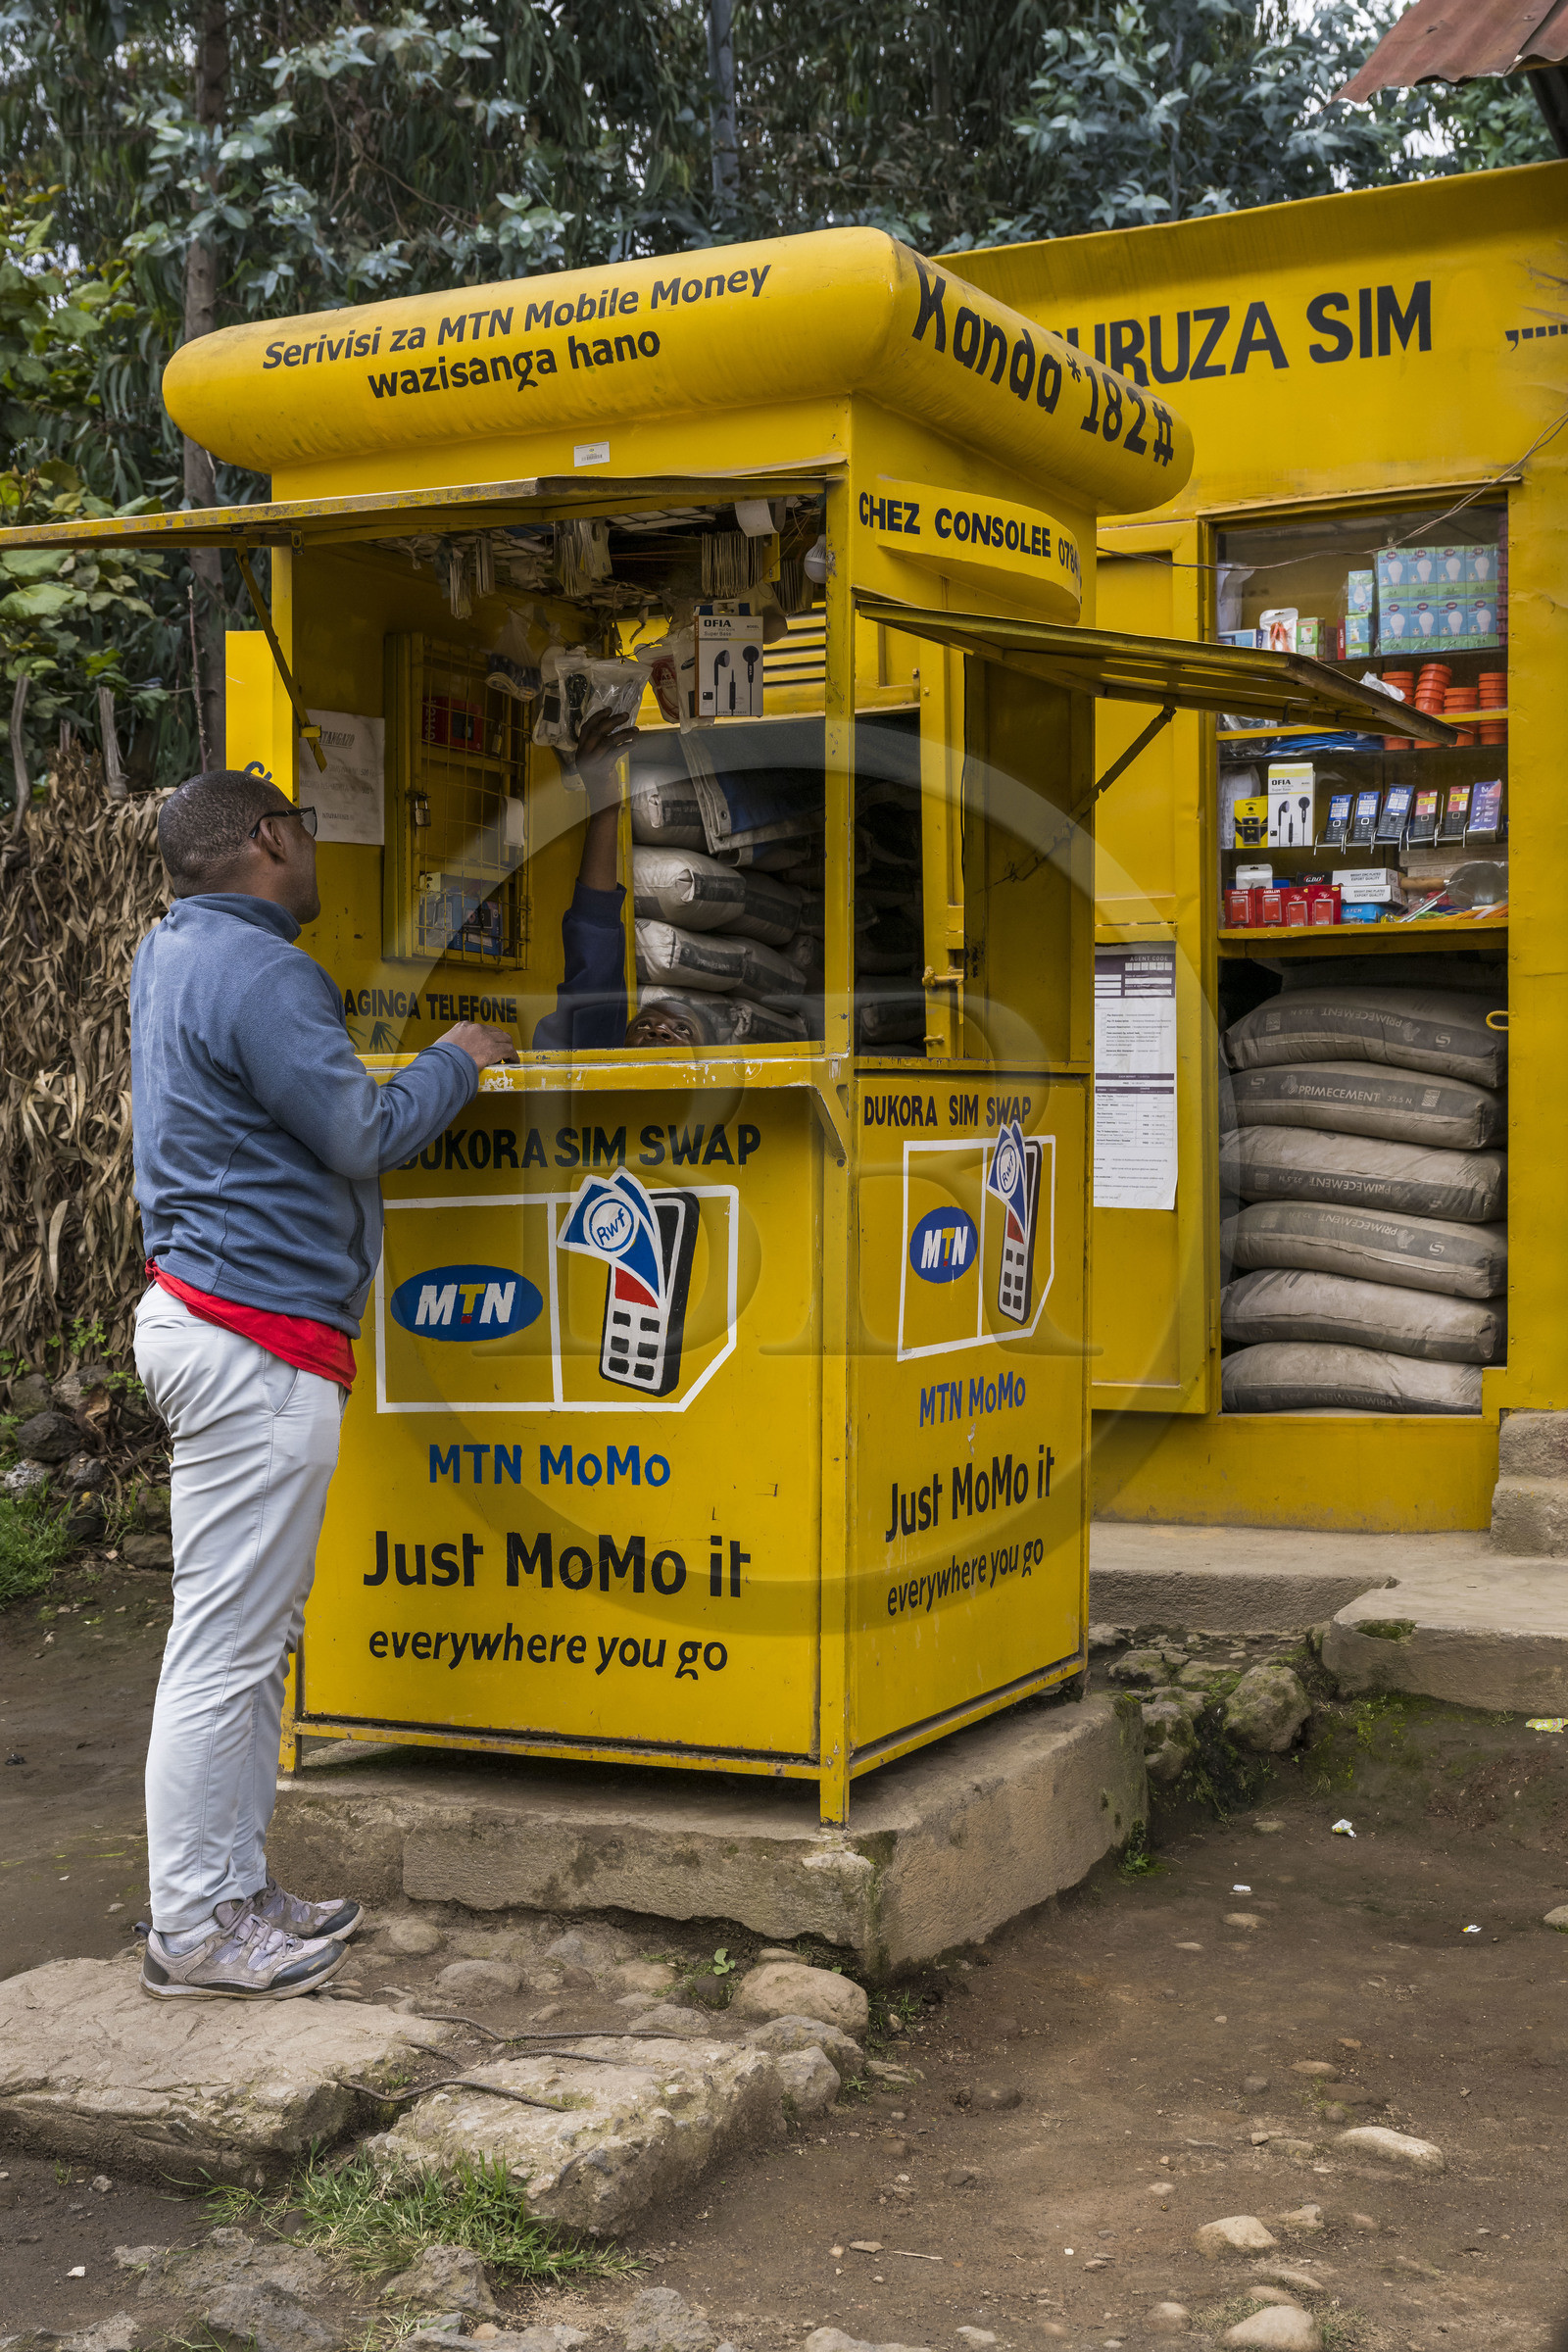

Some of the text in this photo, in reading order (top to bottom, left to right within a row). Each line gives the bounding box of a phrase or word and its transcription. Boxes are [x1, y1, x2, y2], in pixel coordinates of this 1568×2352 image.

[262, 264, 772, 369] Serivisi za MTN Mobile Money
[1305, 280, 1433, 364] SIM
[368, 329, 662, 399] wazisanga hano
[858, 492, 920, 534] CHEZ
[935, 508, 1052, 558] CONSOLEE
[704, 619, 732, 628] OFIA
[425, 992, 517, 1023] TELEFONE
[1320, 1005, 1403, 1029] PRIMECEMENT
[863, 1095, 1031, 1127] DUKORA SIM SWAP
[1298, 1084, 1381, 1102] PRIMECEMENT
[1387, 1095, 1403, 1103] 32.5
[554, 1125, 626, 1167] SIM
[639, 1123, 761, 1166] SWAP
[1308, 1177, 1392, 1195] PRIMECEMENT
[596, 1208, 627, 1246] Rwf
[1318, 1213, 1397, 1236] PRIMECEMENT
[920, 1226, 968, 1269] MTN
[415, 1281, 516, 1325] MTN
[919, 1371, 1026, 1428] MTN MoMo
[428, 1444, 671, 1487] MTN MoMo
[885, 1444, 1054, 1544] Just MoMo it
[364, 1531, 751, 1598] Just MoMo it
[887, 1538, 1044, 1617] everywhere you go
[368, 1623, 728, 1680] everywhere you go
